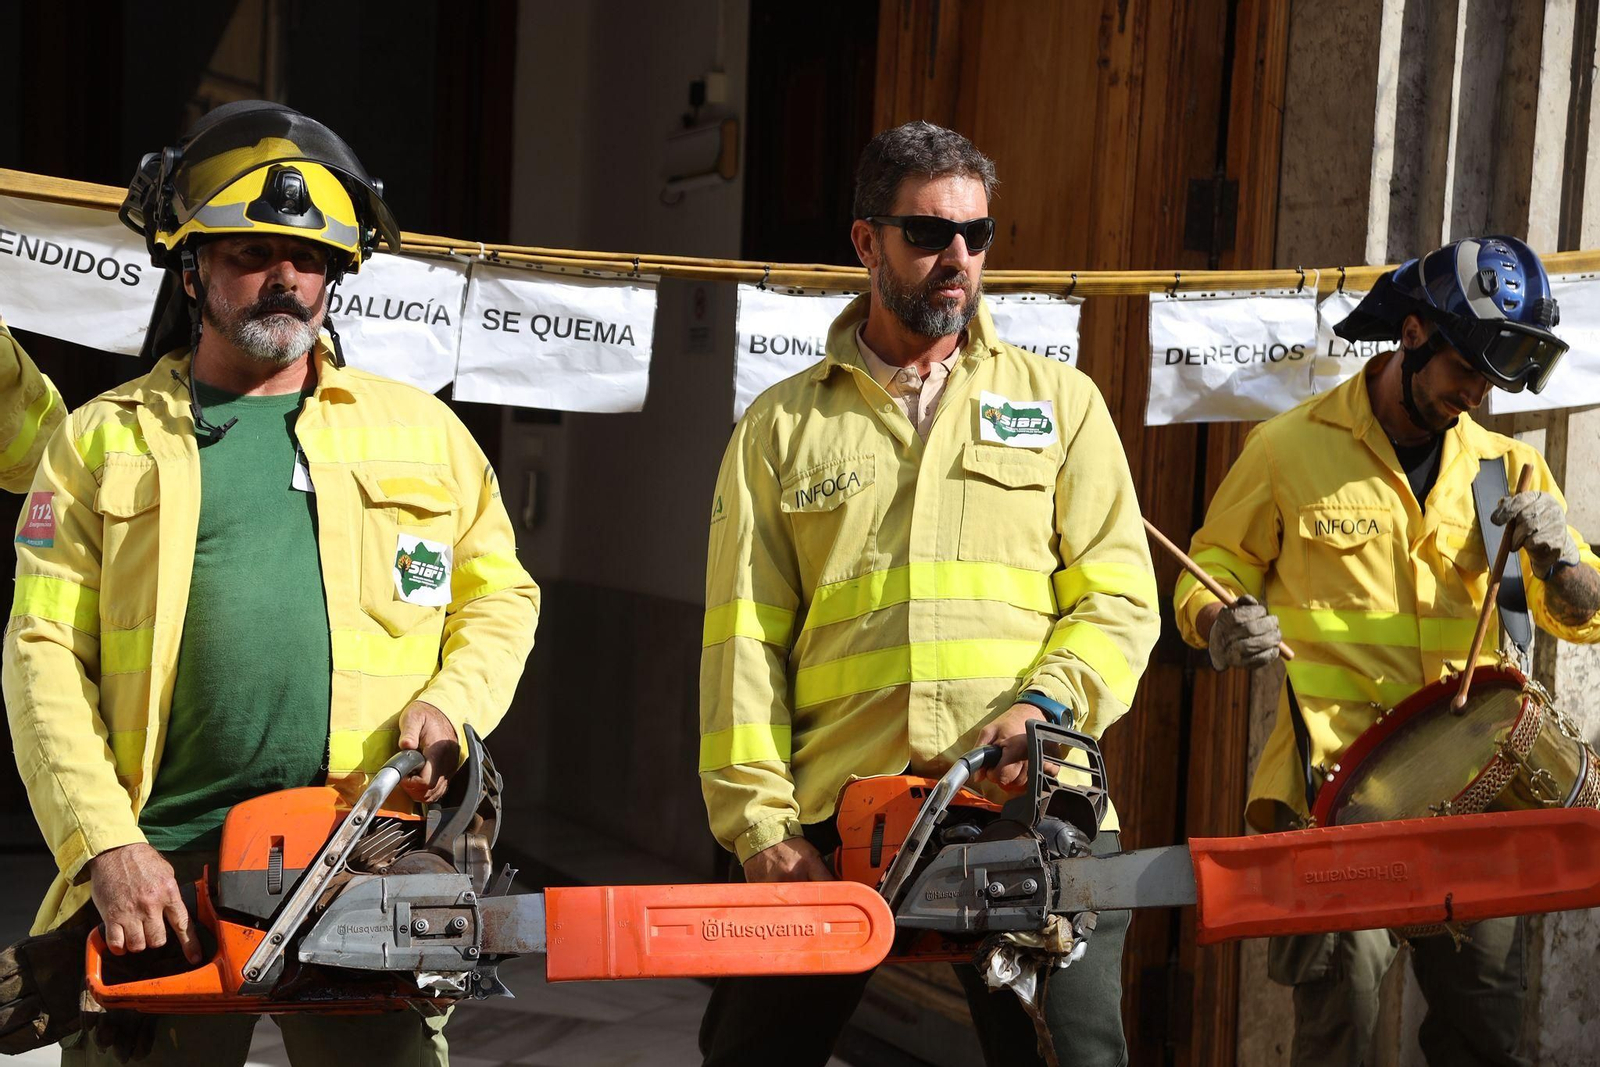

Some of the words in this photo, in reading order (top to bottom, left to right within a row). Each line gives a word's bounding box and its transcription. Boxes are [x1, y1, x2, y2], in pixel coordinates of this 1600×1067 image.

[0, 229, 141, 286] ENDIDOS
[482, 308, 521, 333] SE
[530, 314, 636, 347] QUEMA
[1165, 343, 1306, 366] DERECHOS
[795, 471, 861, 509] INFOCA
[32, 503, 52, 520] 112
[1314, 519, 1380, 536] INFOCA
[1304, 865, 1390, 884] Husqvarna
[346, 924, 395, 934] Husqvarna
[720, 921, 815, 940] Husqvarna
